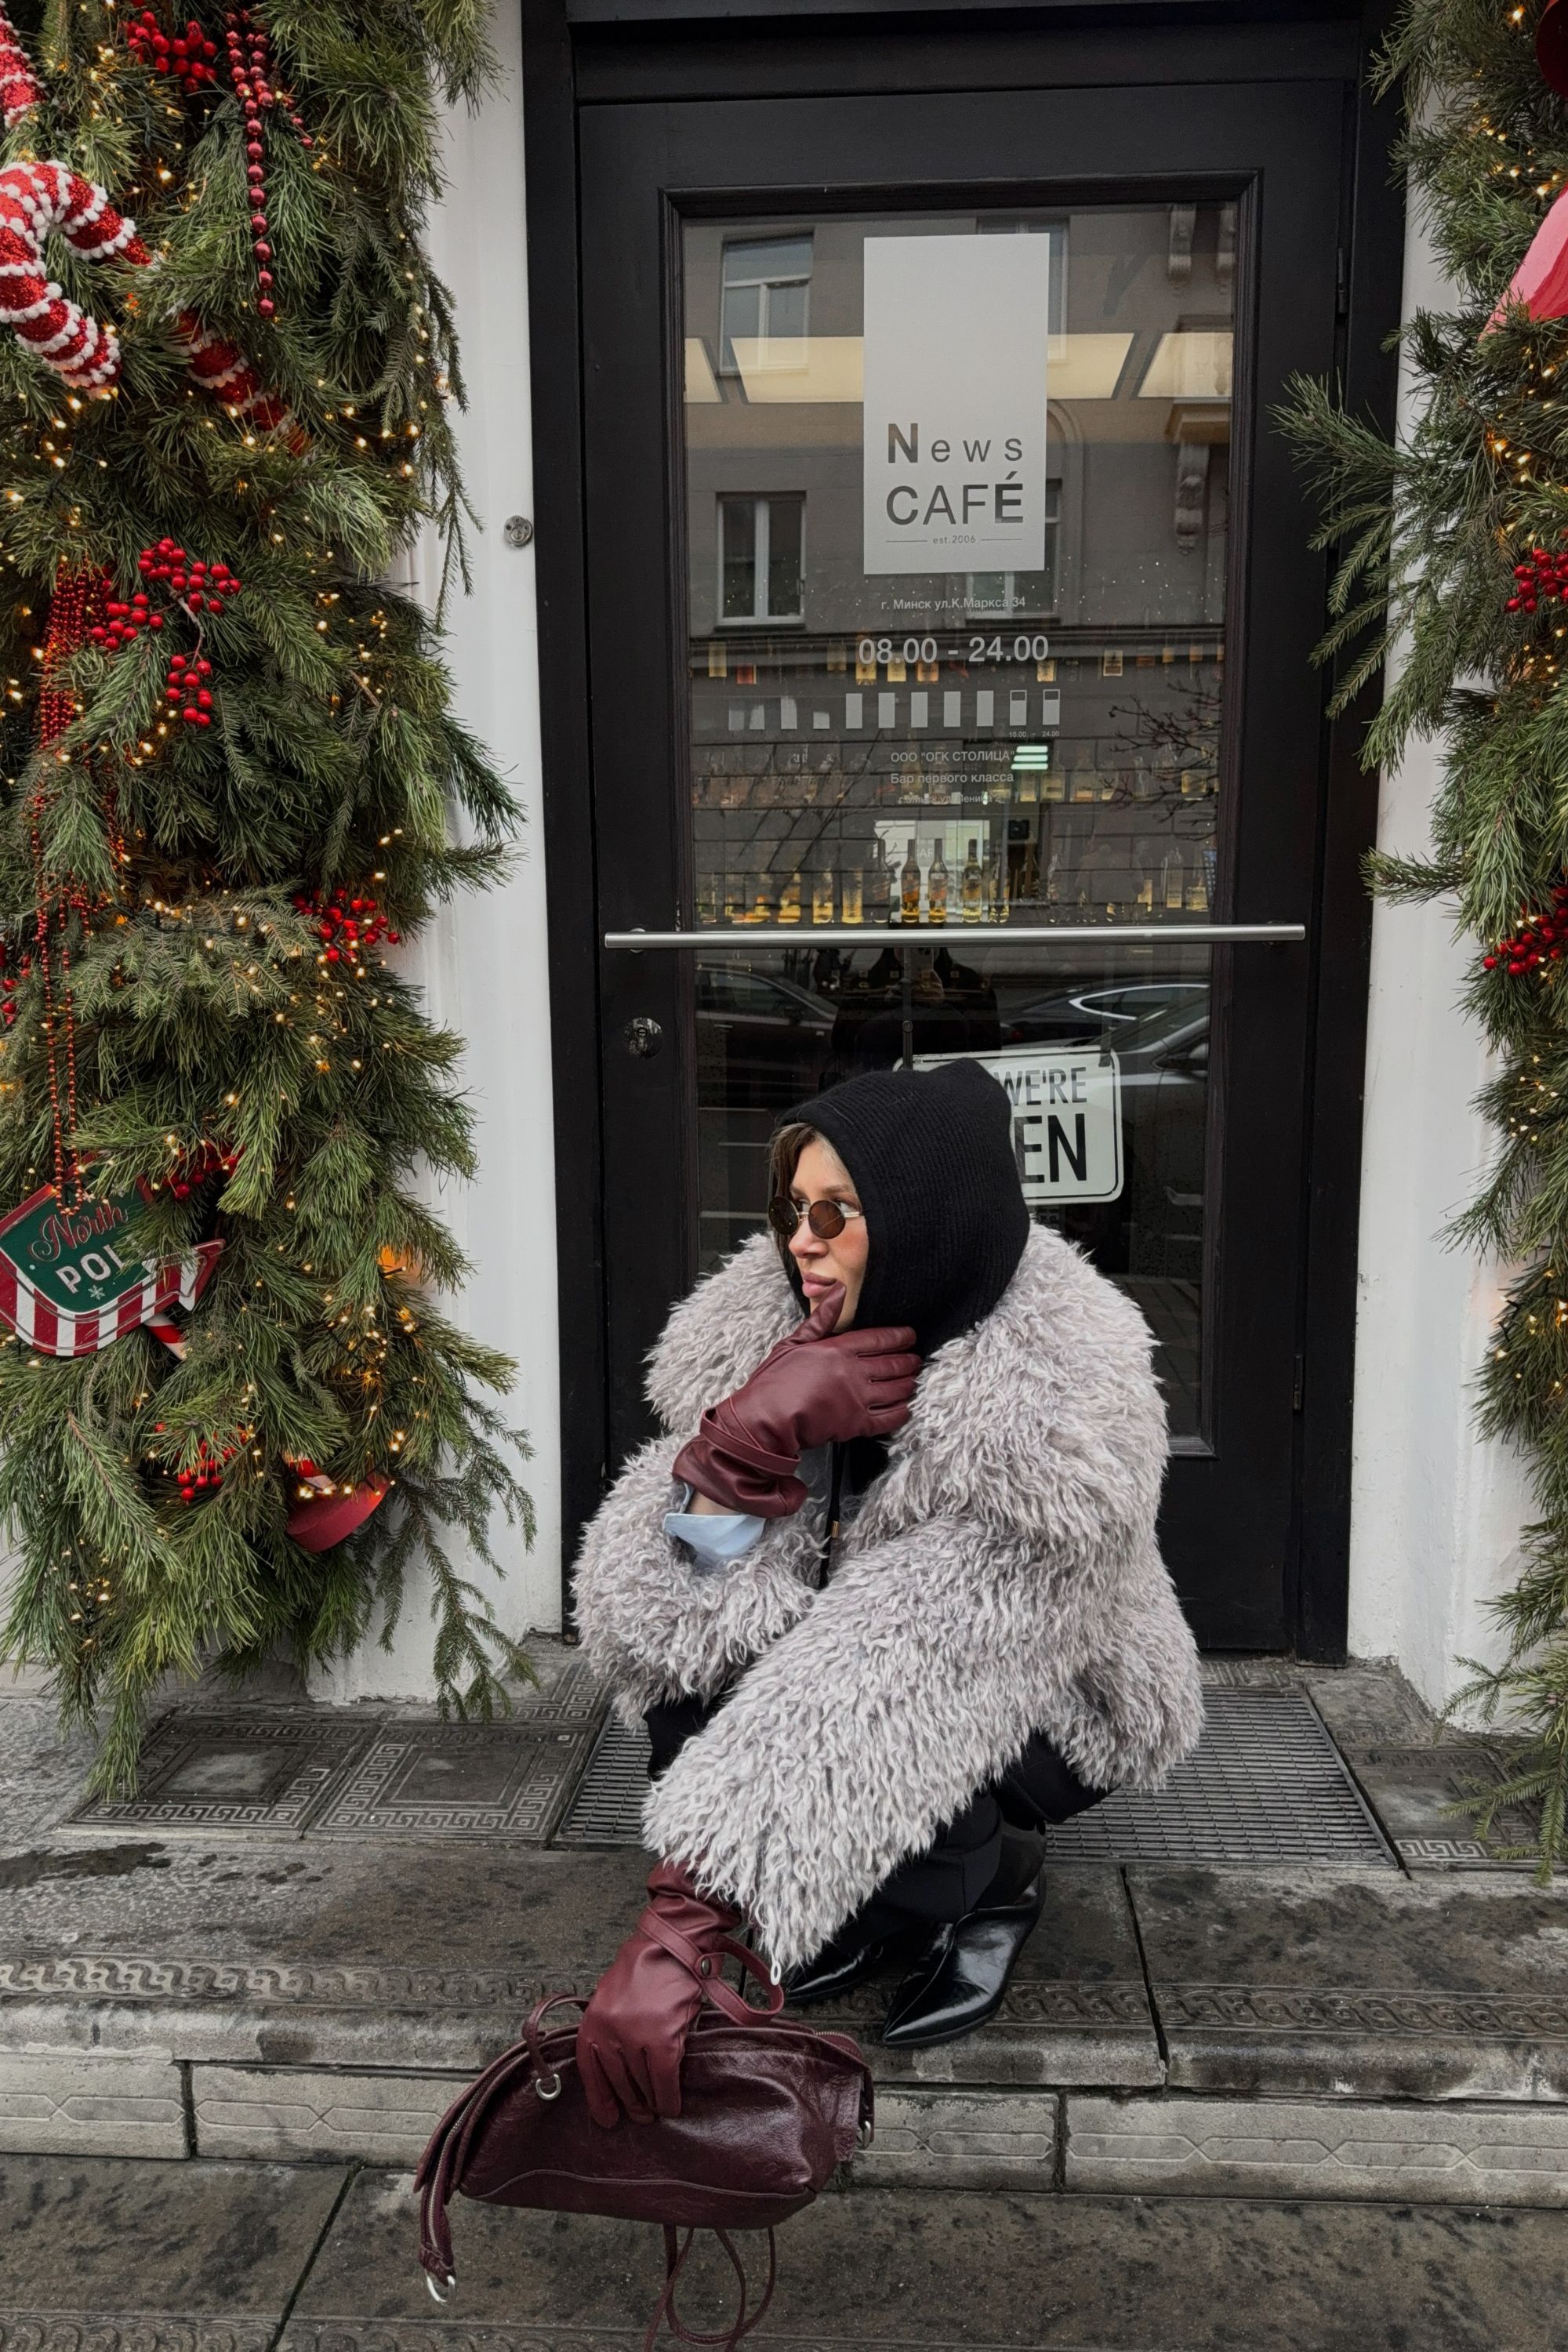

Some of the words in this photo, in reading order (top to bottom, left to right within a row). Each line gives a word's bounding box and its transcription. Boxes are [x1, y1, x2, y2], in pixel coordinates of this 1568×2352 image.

[887, 423, 1023, 464] News
[886, 470, 1023, 525] CAFÉ
[933, 535, 976, 544] est.2006
[894, 599, 931, 610] Минск
[1011, 597, 1026, 608] 34
[858, 637, 938, 664] 08.00
[969, 635, 1048, 662] 24.00
[891, 752, 917, 763] ООО
[953, 750, 1014, 763] СТОЛИЦА"
[891, 773, 914, 786] Бар
[917, 772, 967, 786] первого
[971, 773, 1014, 782] класса
[993, 1067, 1087, 1106] WE'RE
[1014, 1112, 1087, 1183] EN
[29, 1201, 129, 1262] North
[56, 1229, 133, 1294] POL
